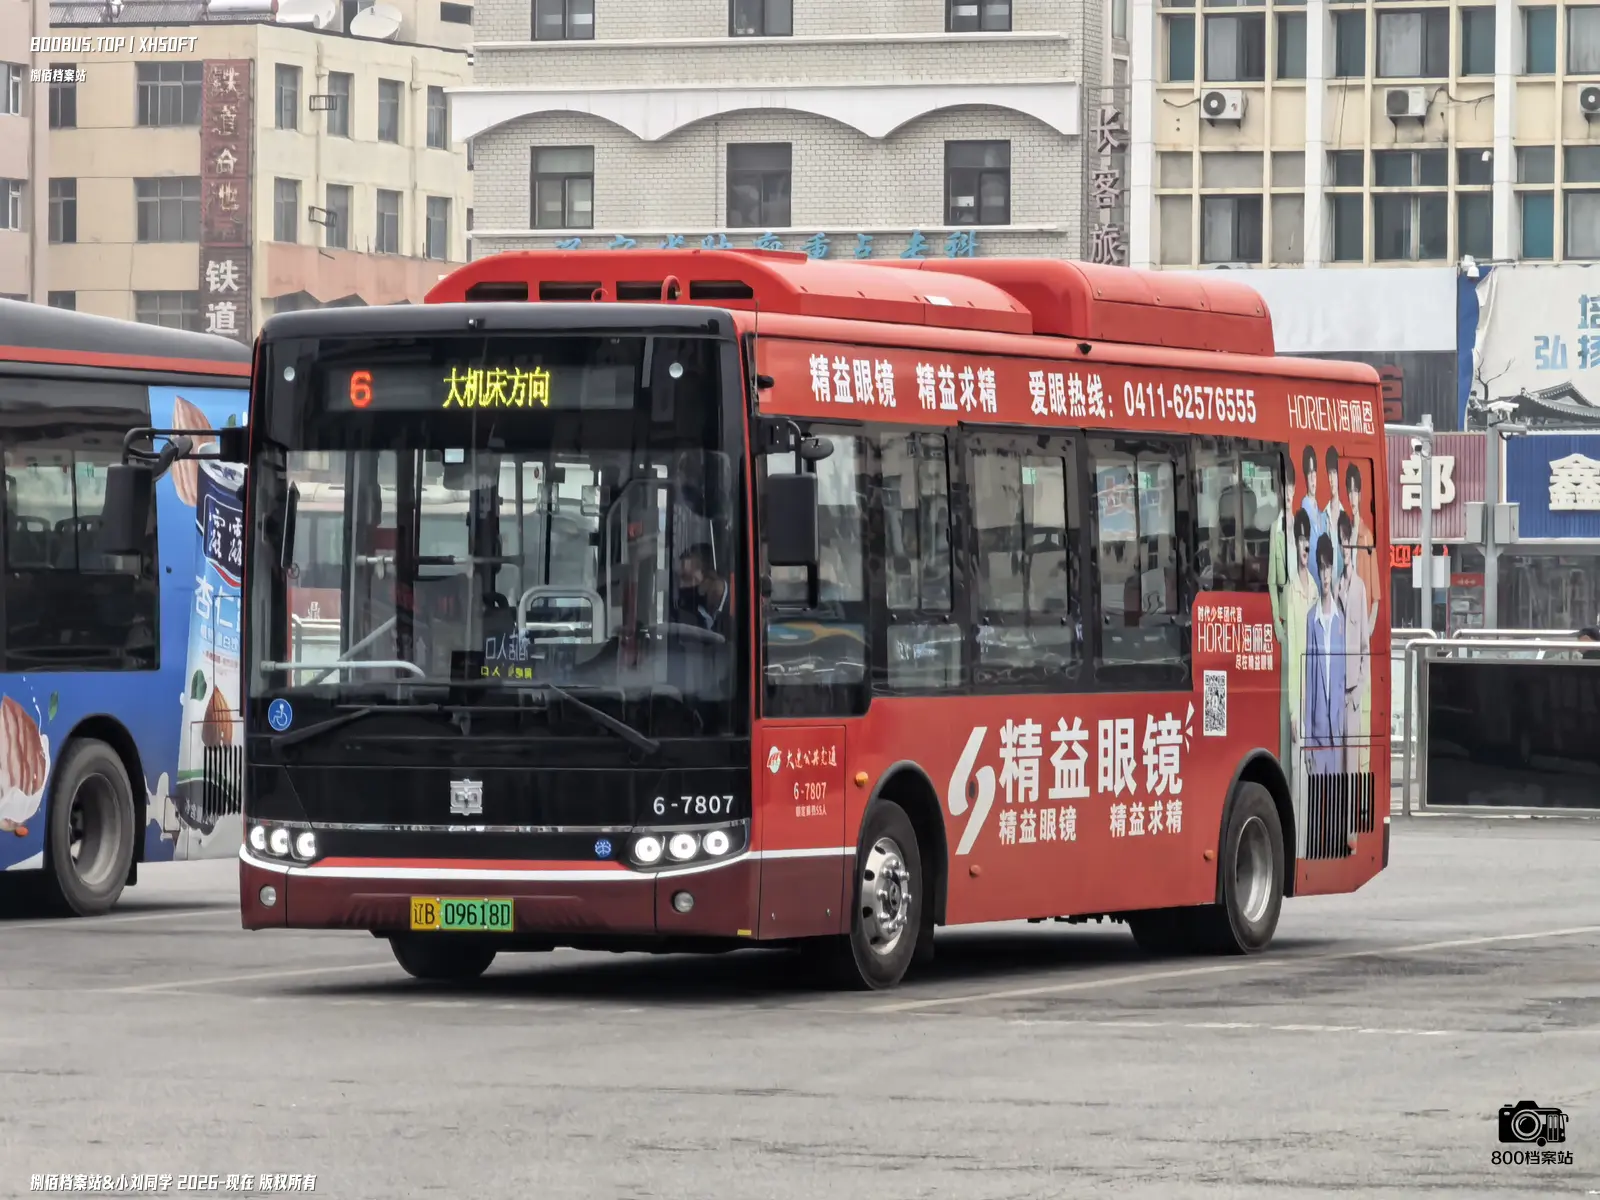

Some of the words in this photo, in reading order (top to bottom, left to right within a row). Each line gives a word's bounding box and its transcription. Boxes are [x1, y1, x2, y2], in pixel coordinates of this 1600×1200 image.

[205, 259, 240, 335] 铁道
[350, 370, 373, 409] 6
[443, 366, 551, 409] 大机床方向
[809, 353, 897, 408] 精益眼镜
[915, 361, 998, 413] 精益求精
[1123, 380, 1257, 424] 0411-62576555
[1400, 453, 1455, 510] 部
[1548, 452, 1600, 511] 鑫
[194, 575, 241, 633] 杏仁
[999, 712, 1183, 803] 精益眼镜
[652, 795, 735, 815] 6-7807
[793, 782, 827, 800] 6-7807
[999, 806, 1077, 845] 精益眼镜
[1109, 799, 1183, 838] 精益求精
